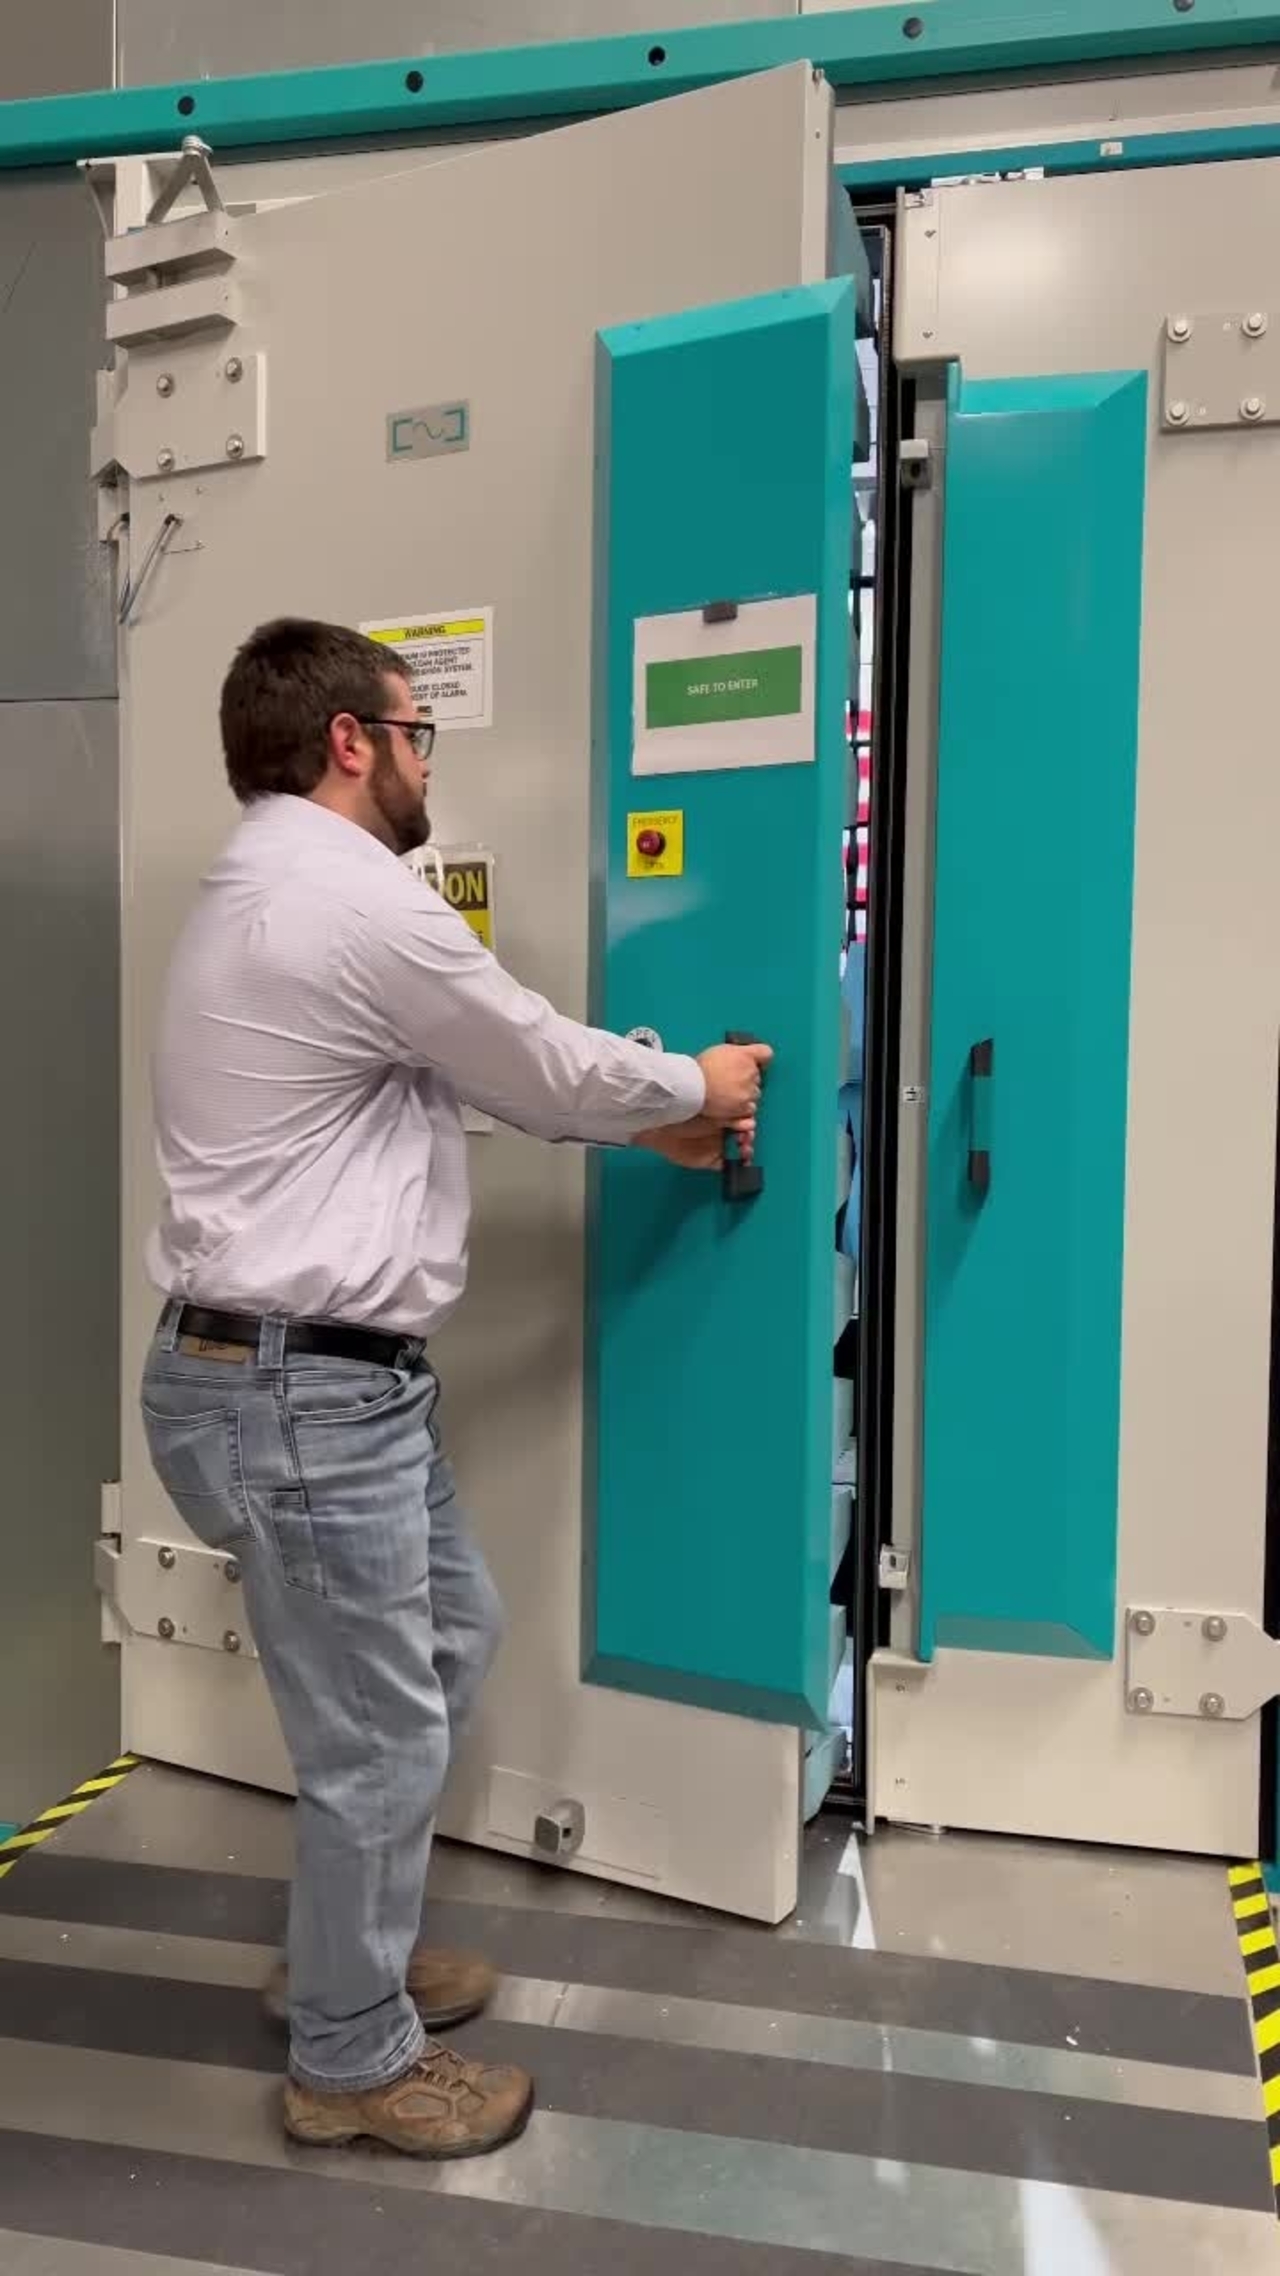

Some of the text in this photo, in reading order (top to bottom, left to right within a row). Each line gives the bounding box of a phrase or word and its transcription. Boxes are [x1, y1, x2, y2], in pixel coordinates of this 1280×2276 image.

[404, 625, 446, 639] WARNING
[434, 656, 458, 665] AGENT
[687, 679, 758, 696] SAFE TO ENTER
